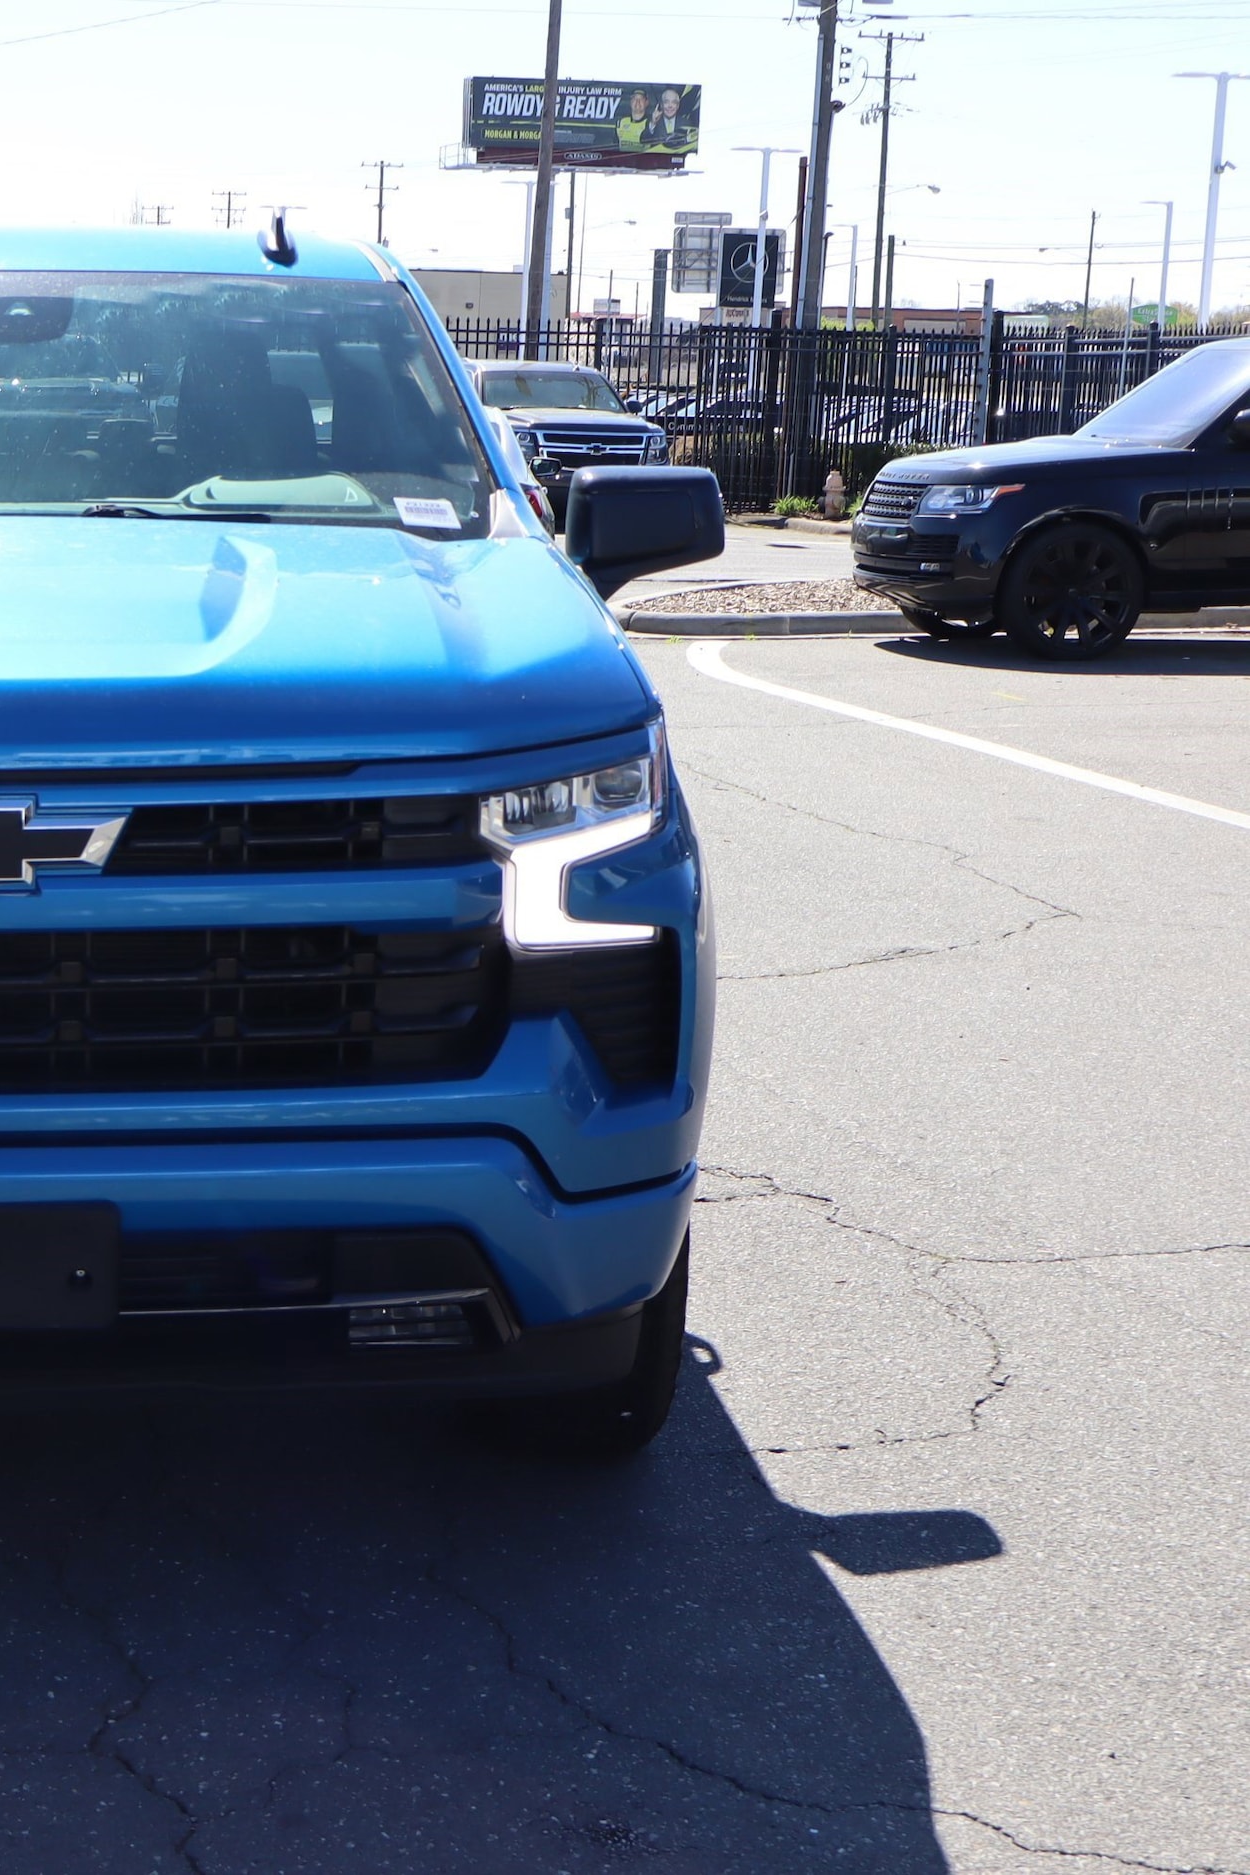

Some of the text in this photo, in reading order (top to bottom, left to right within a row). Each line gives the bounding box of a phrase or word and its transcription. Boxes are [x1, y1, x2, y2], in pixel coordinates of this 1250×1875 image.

[484, 84, 622, 96] AMERICA'S LARG INJURY LAW FIRM
[482, 93, 545, 117] ROWDY
[562, 96, 621, 119] READY
[484, 130, 542, 140] MORGAN & MORGA
